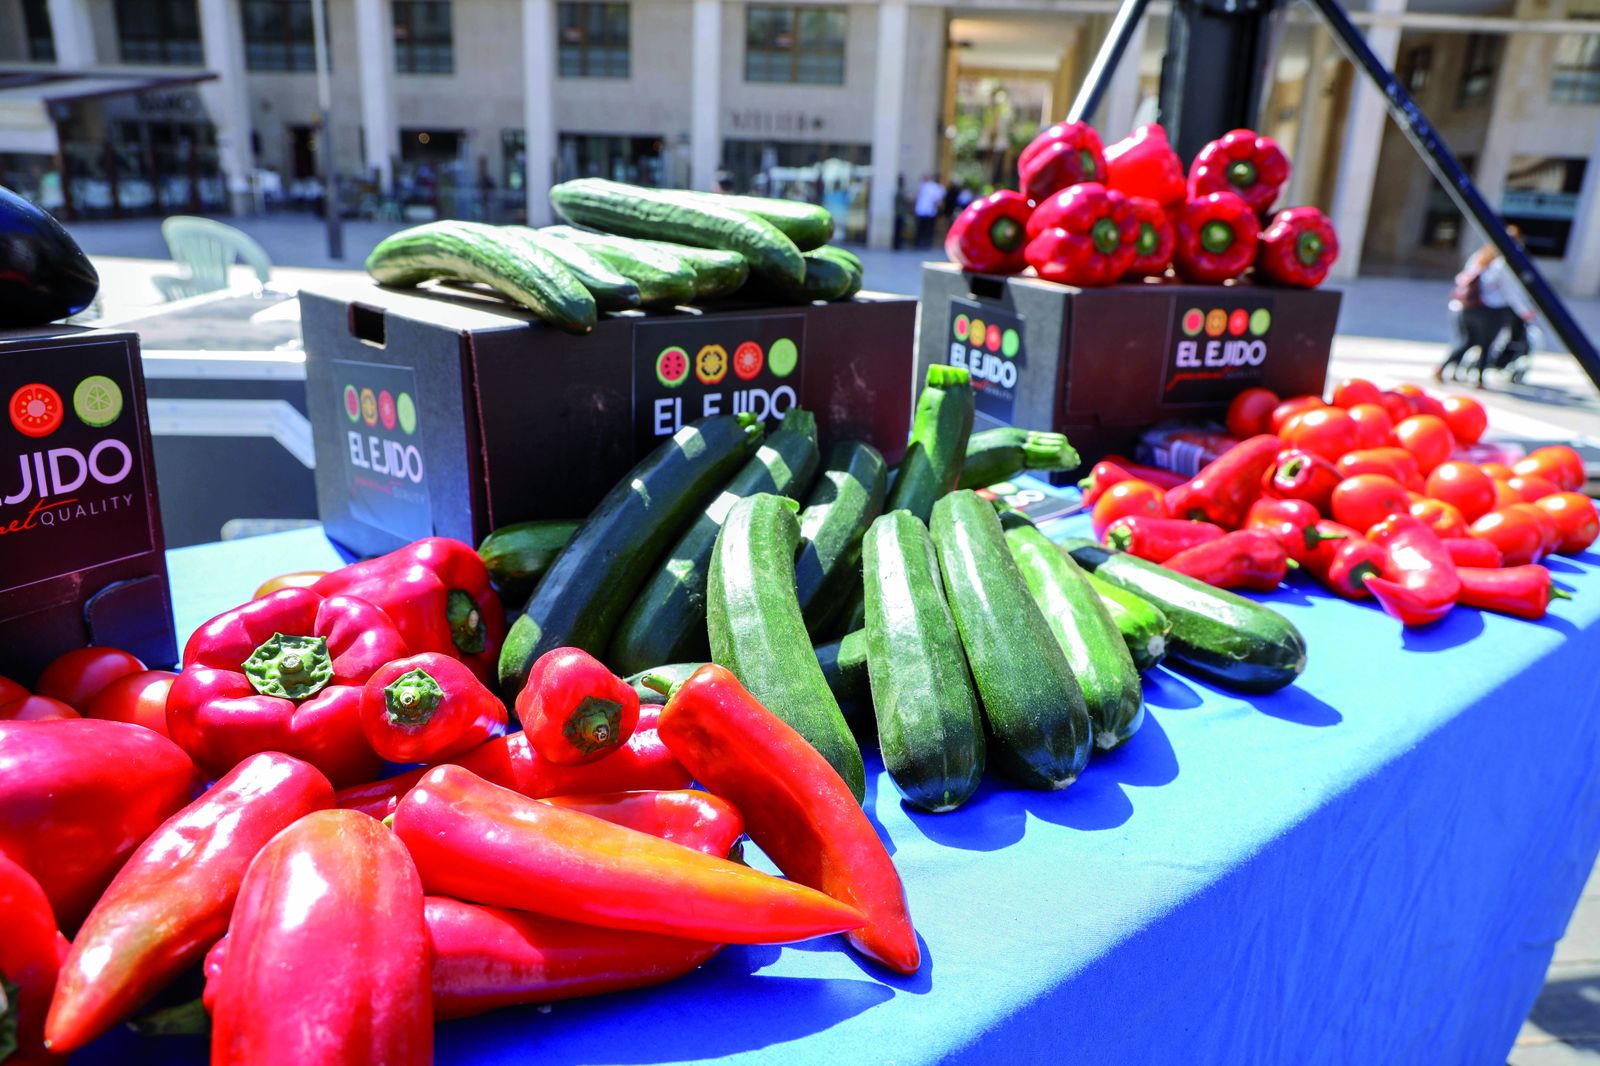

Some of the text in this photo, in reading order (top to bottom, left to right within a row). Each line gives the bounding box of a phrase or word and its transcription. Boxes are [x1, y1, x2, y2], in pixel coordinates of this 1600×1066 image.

[970, 349, 1017, 388] EJIDO
[1176, 340, 1266, 367] EL EJIDO
[0, 438, 132, 506] JIDO
[348, 431, 423, 483] EL EJIDO
[41, 494, 133, 526] QUALITY
